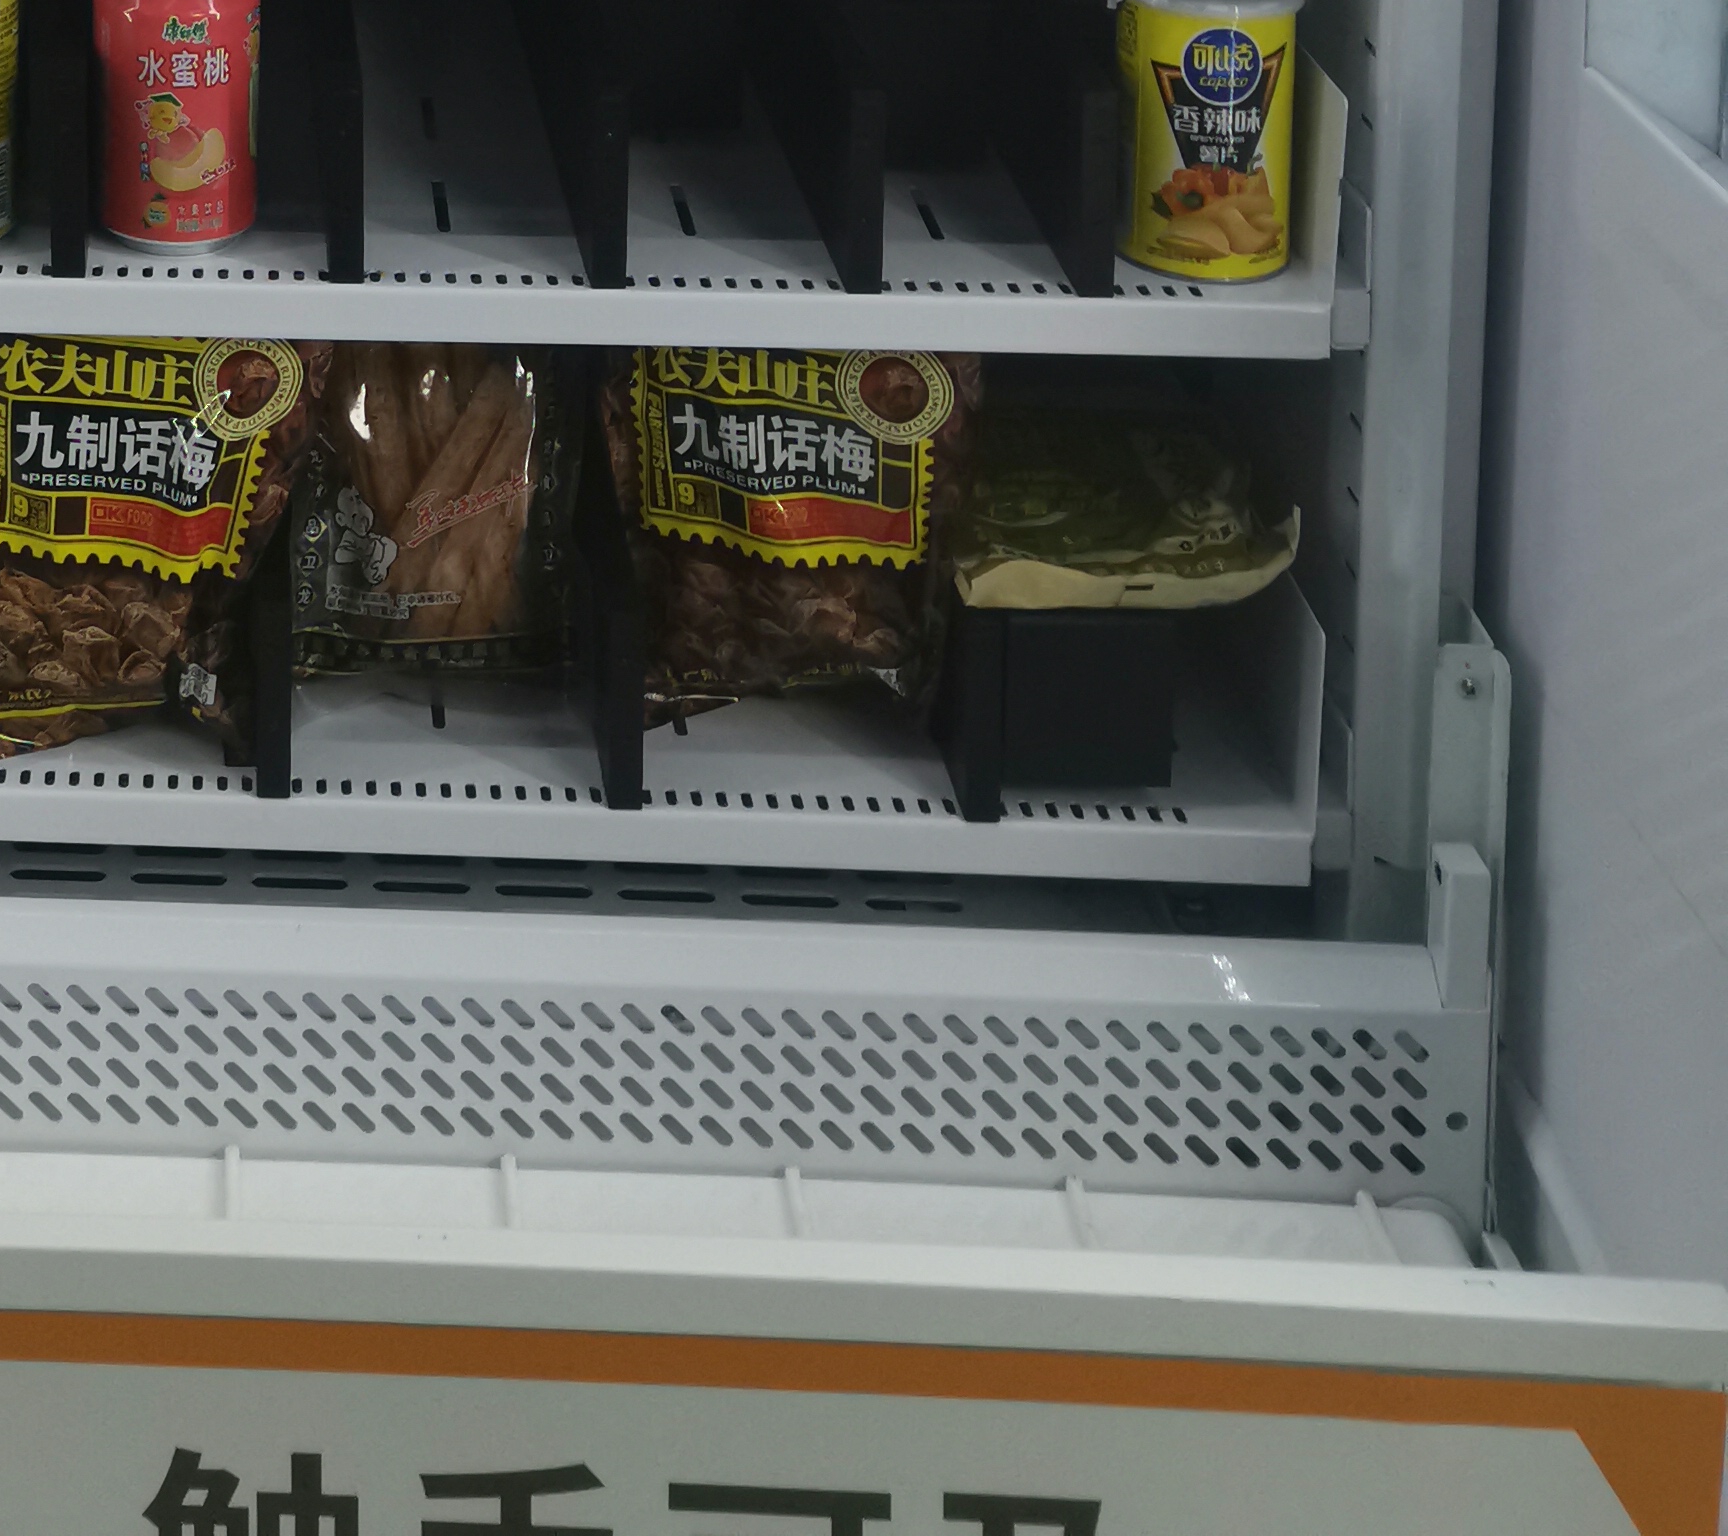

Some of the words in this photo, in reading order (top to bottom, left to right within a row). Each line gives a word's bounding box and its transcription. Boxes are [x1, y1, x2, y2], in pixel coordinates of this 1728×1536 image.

[137, 50, 230, 88] 水蜜桃
[1192, 42, 1255, 76] 可比克
[1172, 104, 1261, 136] 香辣味
[652, 347, 839, 410] 农夫山庄
[14, 410, 218, 492] 九制话梅
[672, 403, 876, 482] 九制话梅
[29, 471, 147, 492] PRESERVED
[152, 480, 193, 506] PLUM
[692, 458, 797, 492] PRESERVED
[802, 474, 856, 495] PLUM
